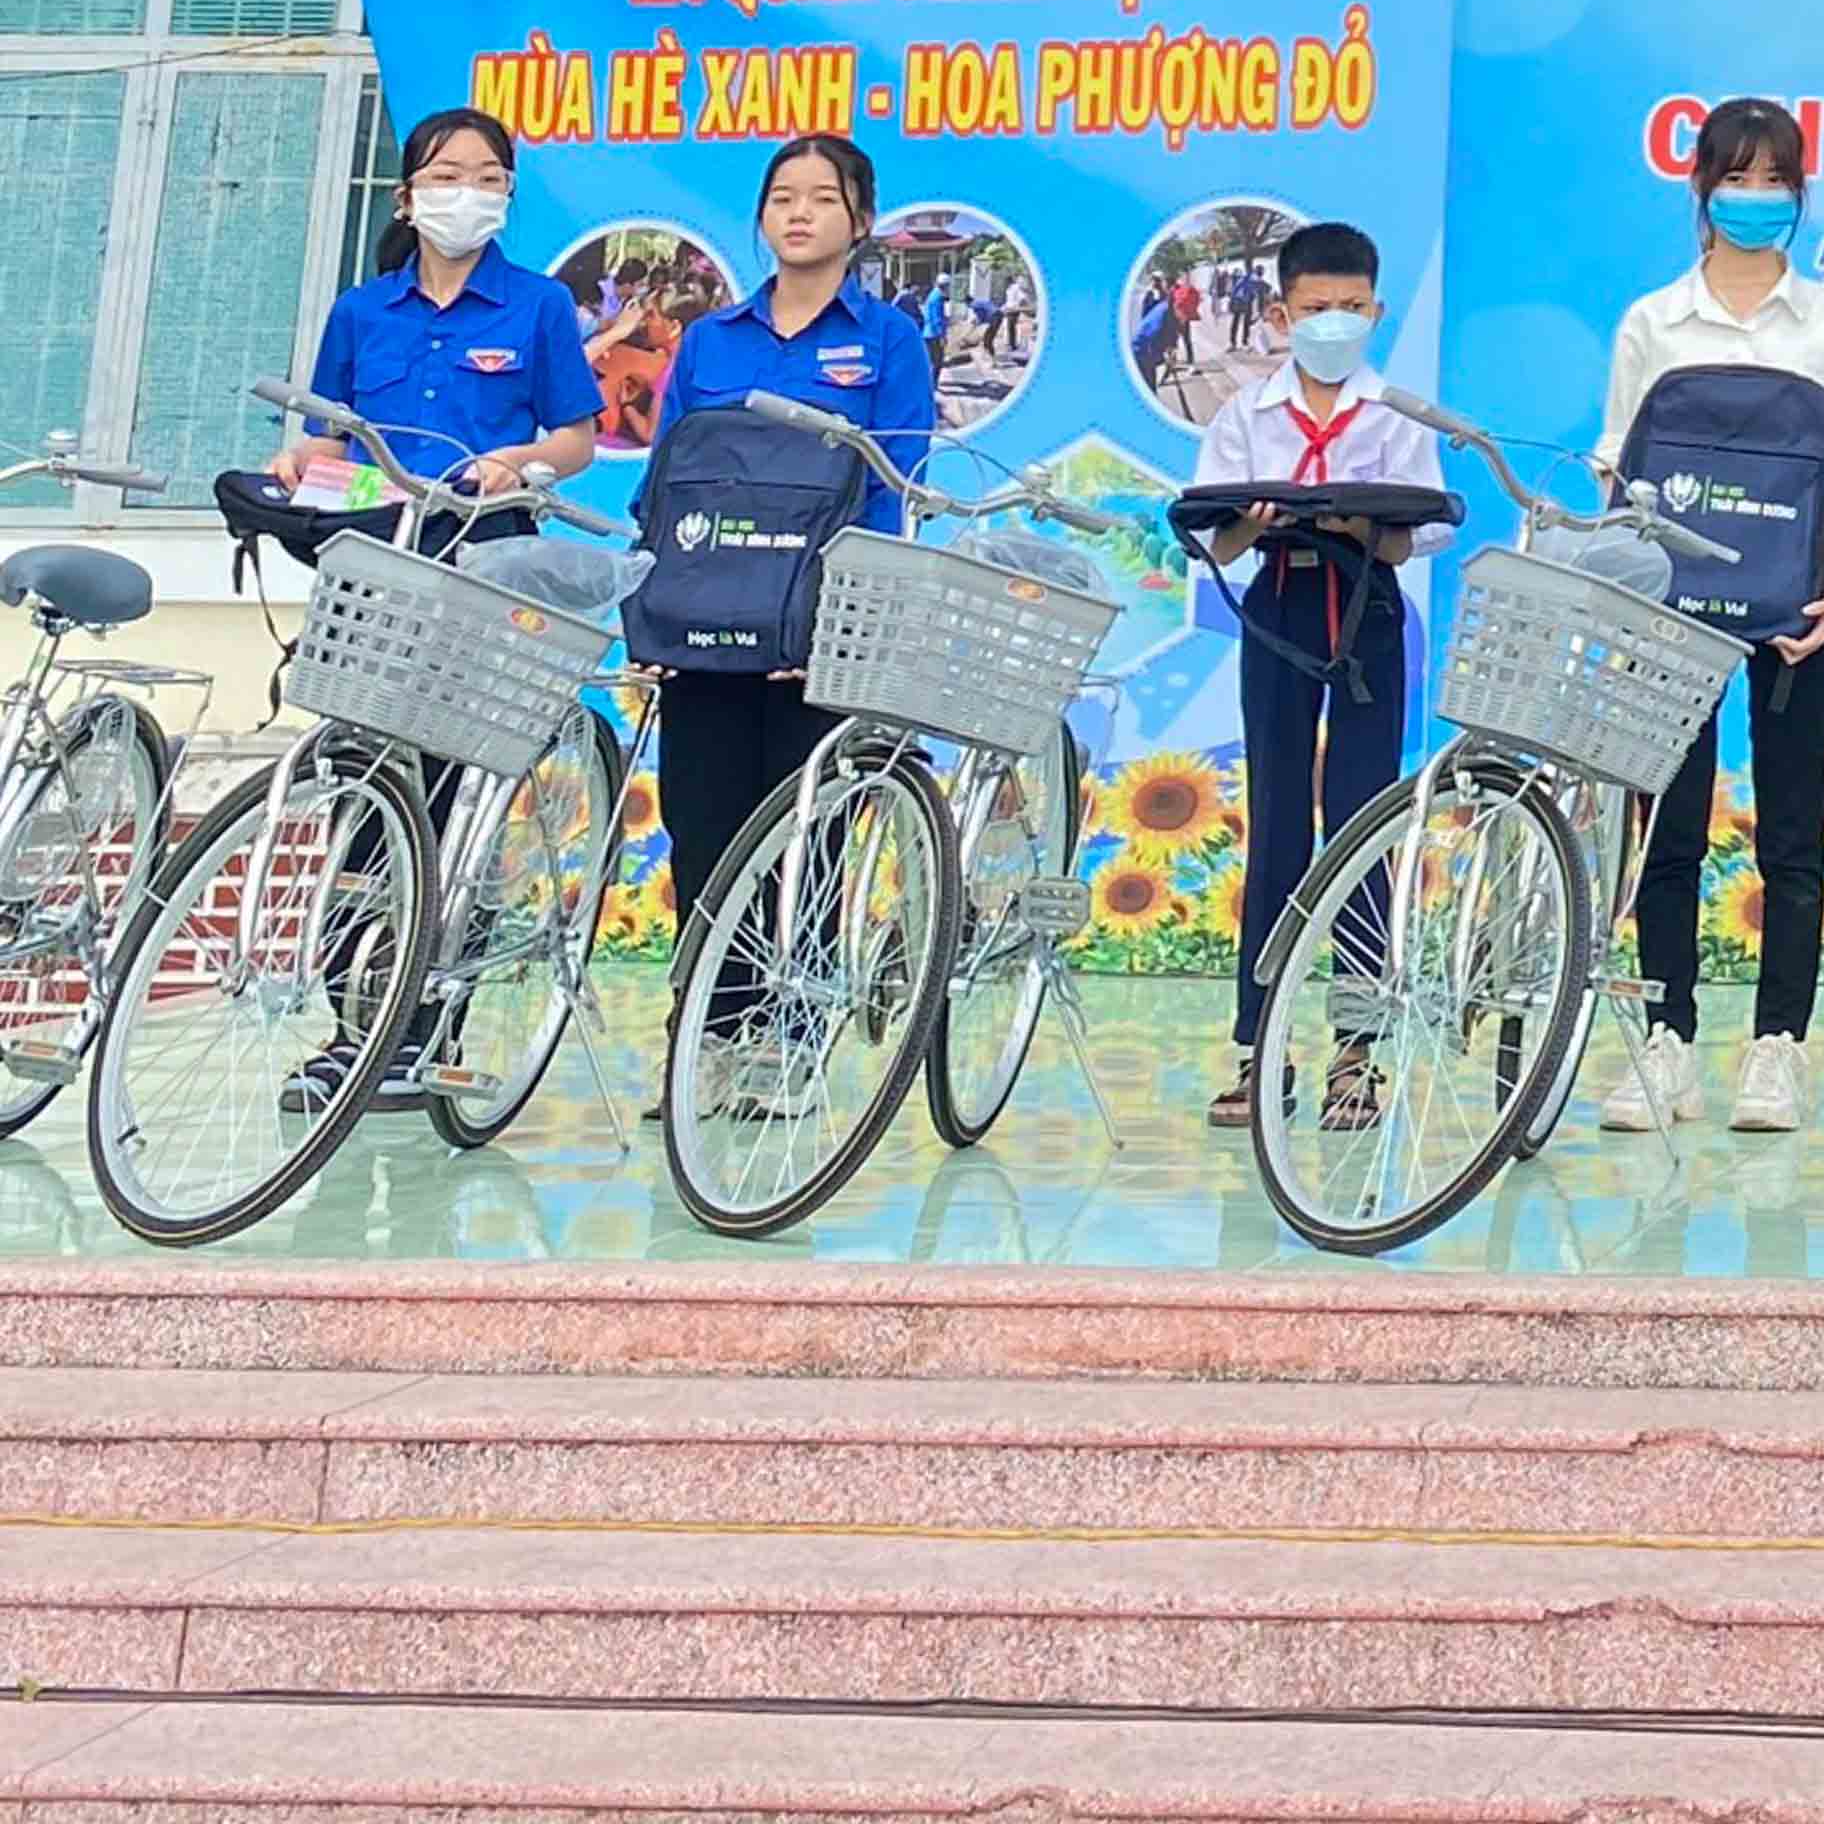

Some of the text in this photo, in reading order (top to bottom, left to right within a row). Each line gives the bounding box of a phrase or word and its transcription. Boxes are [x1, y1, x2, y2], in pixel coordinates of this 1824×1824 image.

[473, 31, 595, 142] MÙA
[607, 26, 685, 139] HÈ
[697, 45, 855, 139] XANH
[903, 39, 1022, 134] HOA
[1038, 25, 1279, 150] PHƯỢNG
[1290, 4, 1376, 130] ĐỎ
